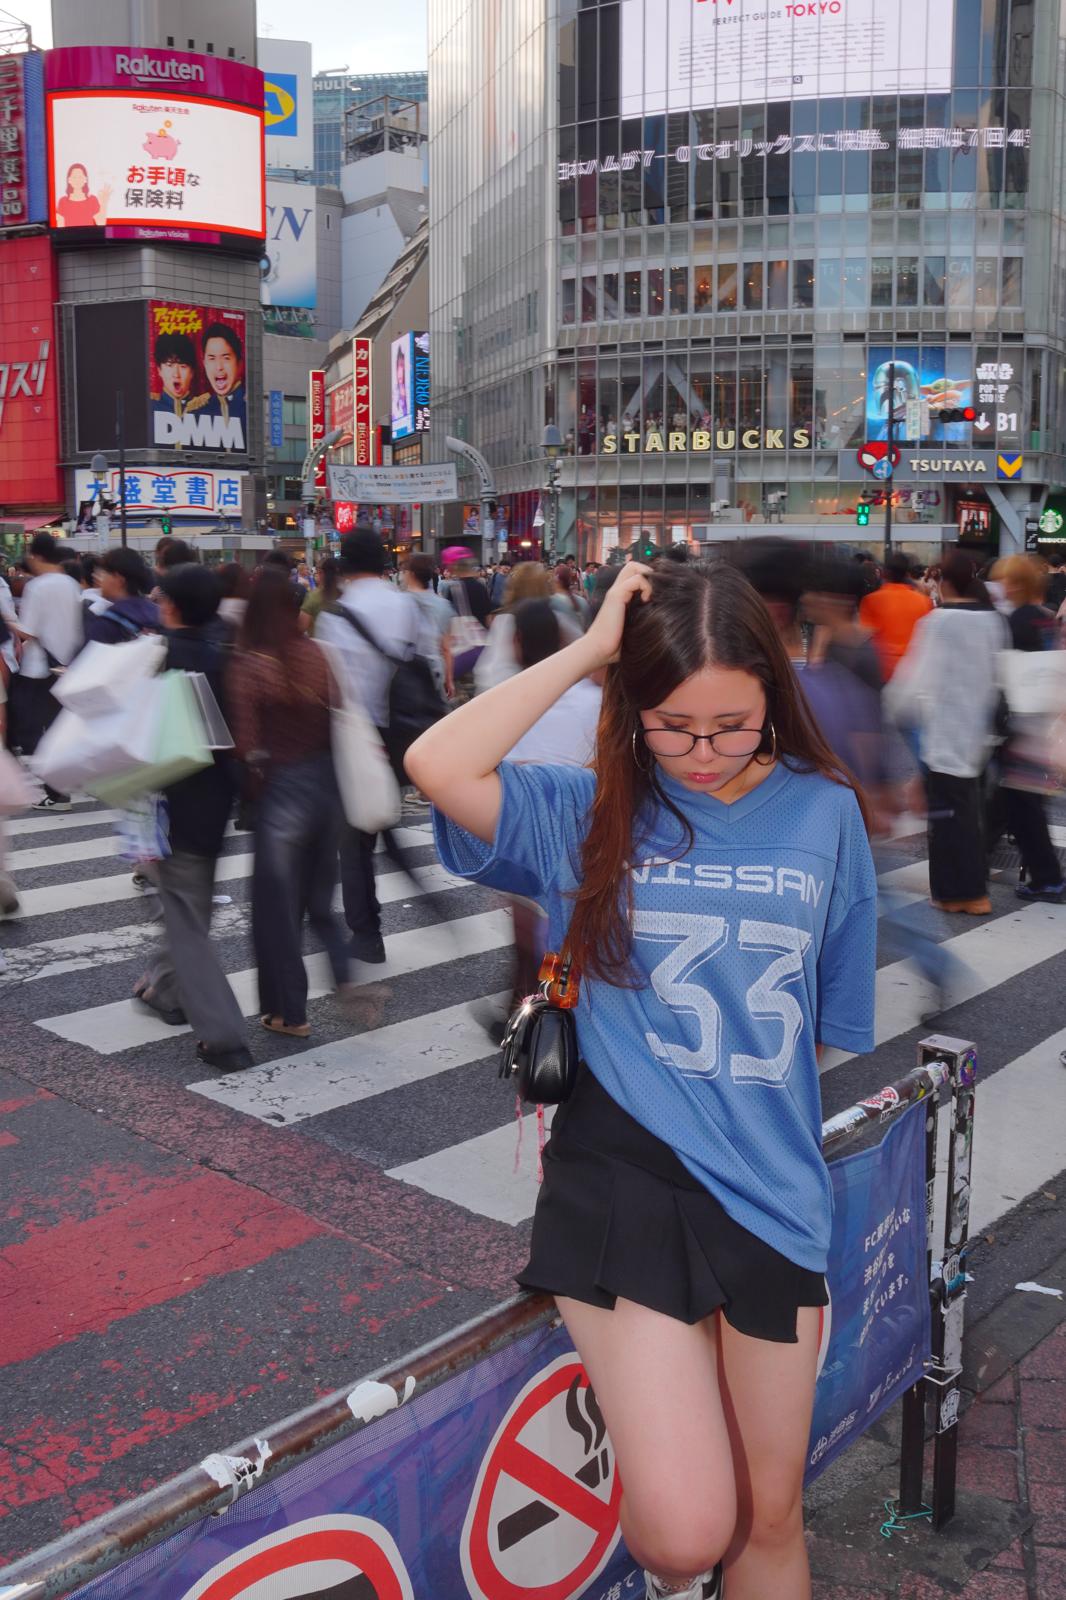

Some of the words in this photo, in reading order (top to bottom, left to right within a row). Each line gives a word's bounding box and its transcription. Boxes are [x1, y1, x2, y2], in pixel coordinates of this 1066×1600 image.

[752, 11, 782, 21] GUDE
[785, 1, 841, 17] TOKYO
[115, 54, 205, 82] Rakuten
[127, 165, 201, 187] お手頃な
[124, 187, 184, 211] 保険料
[948, 261, 993, 274] CAFE
[356, 348, 369, 414] カラオケ
[154, 410, 245, 450] DMM
[997, 413, 1017, 432] B1
[603, 429, 810, 453] STARBUCKS
[910, 460, 987, 472] TSUTAYA
[86, 476, 239, 506] 大盛堂書店
[623, 857, 825, 908] NISSAN
[627, 910, 814, 1088] 33
